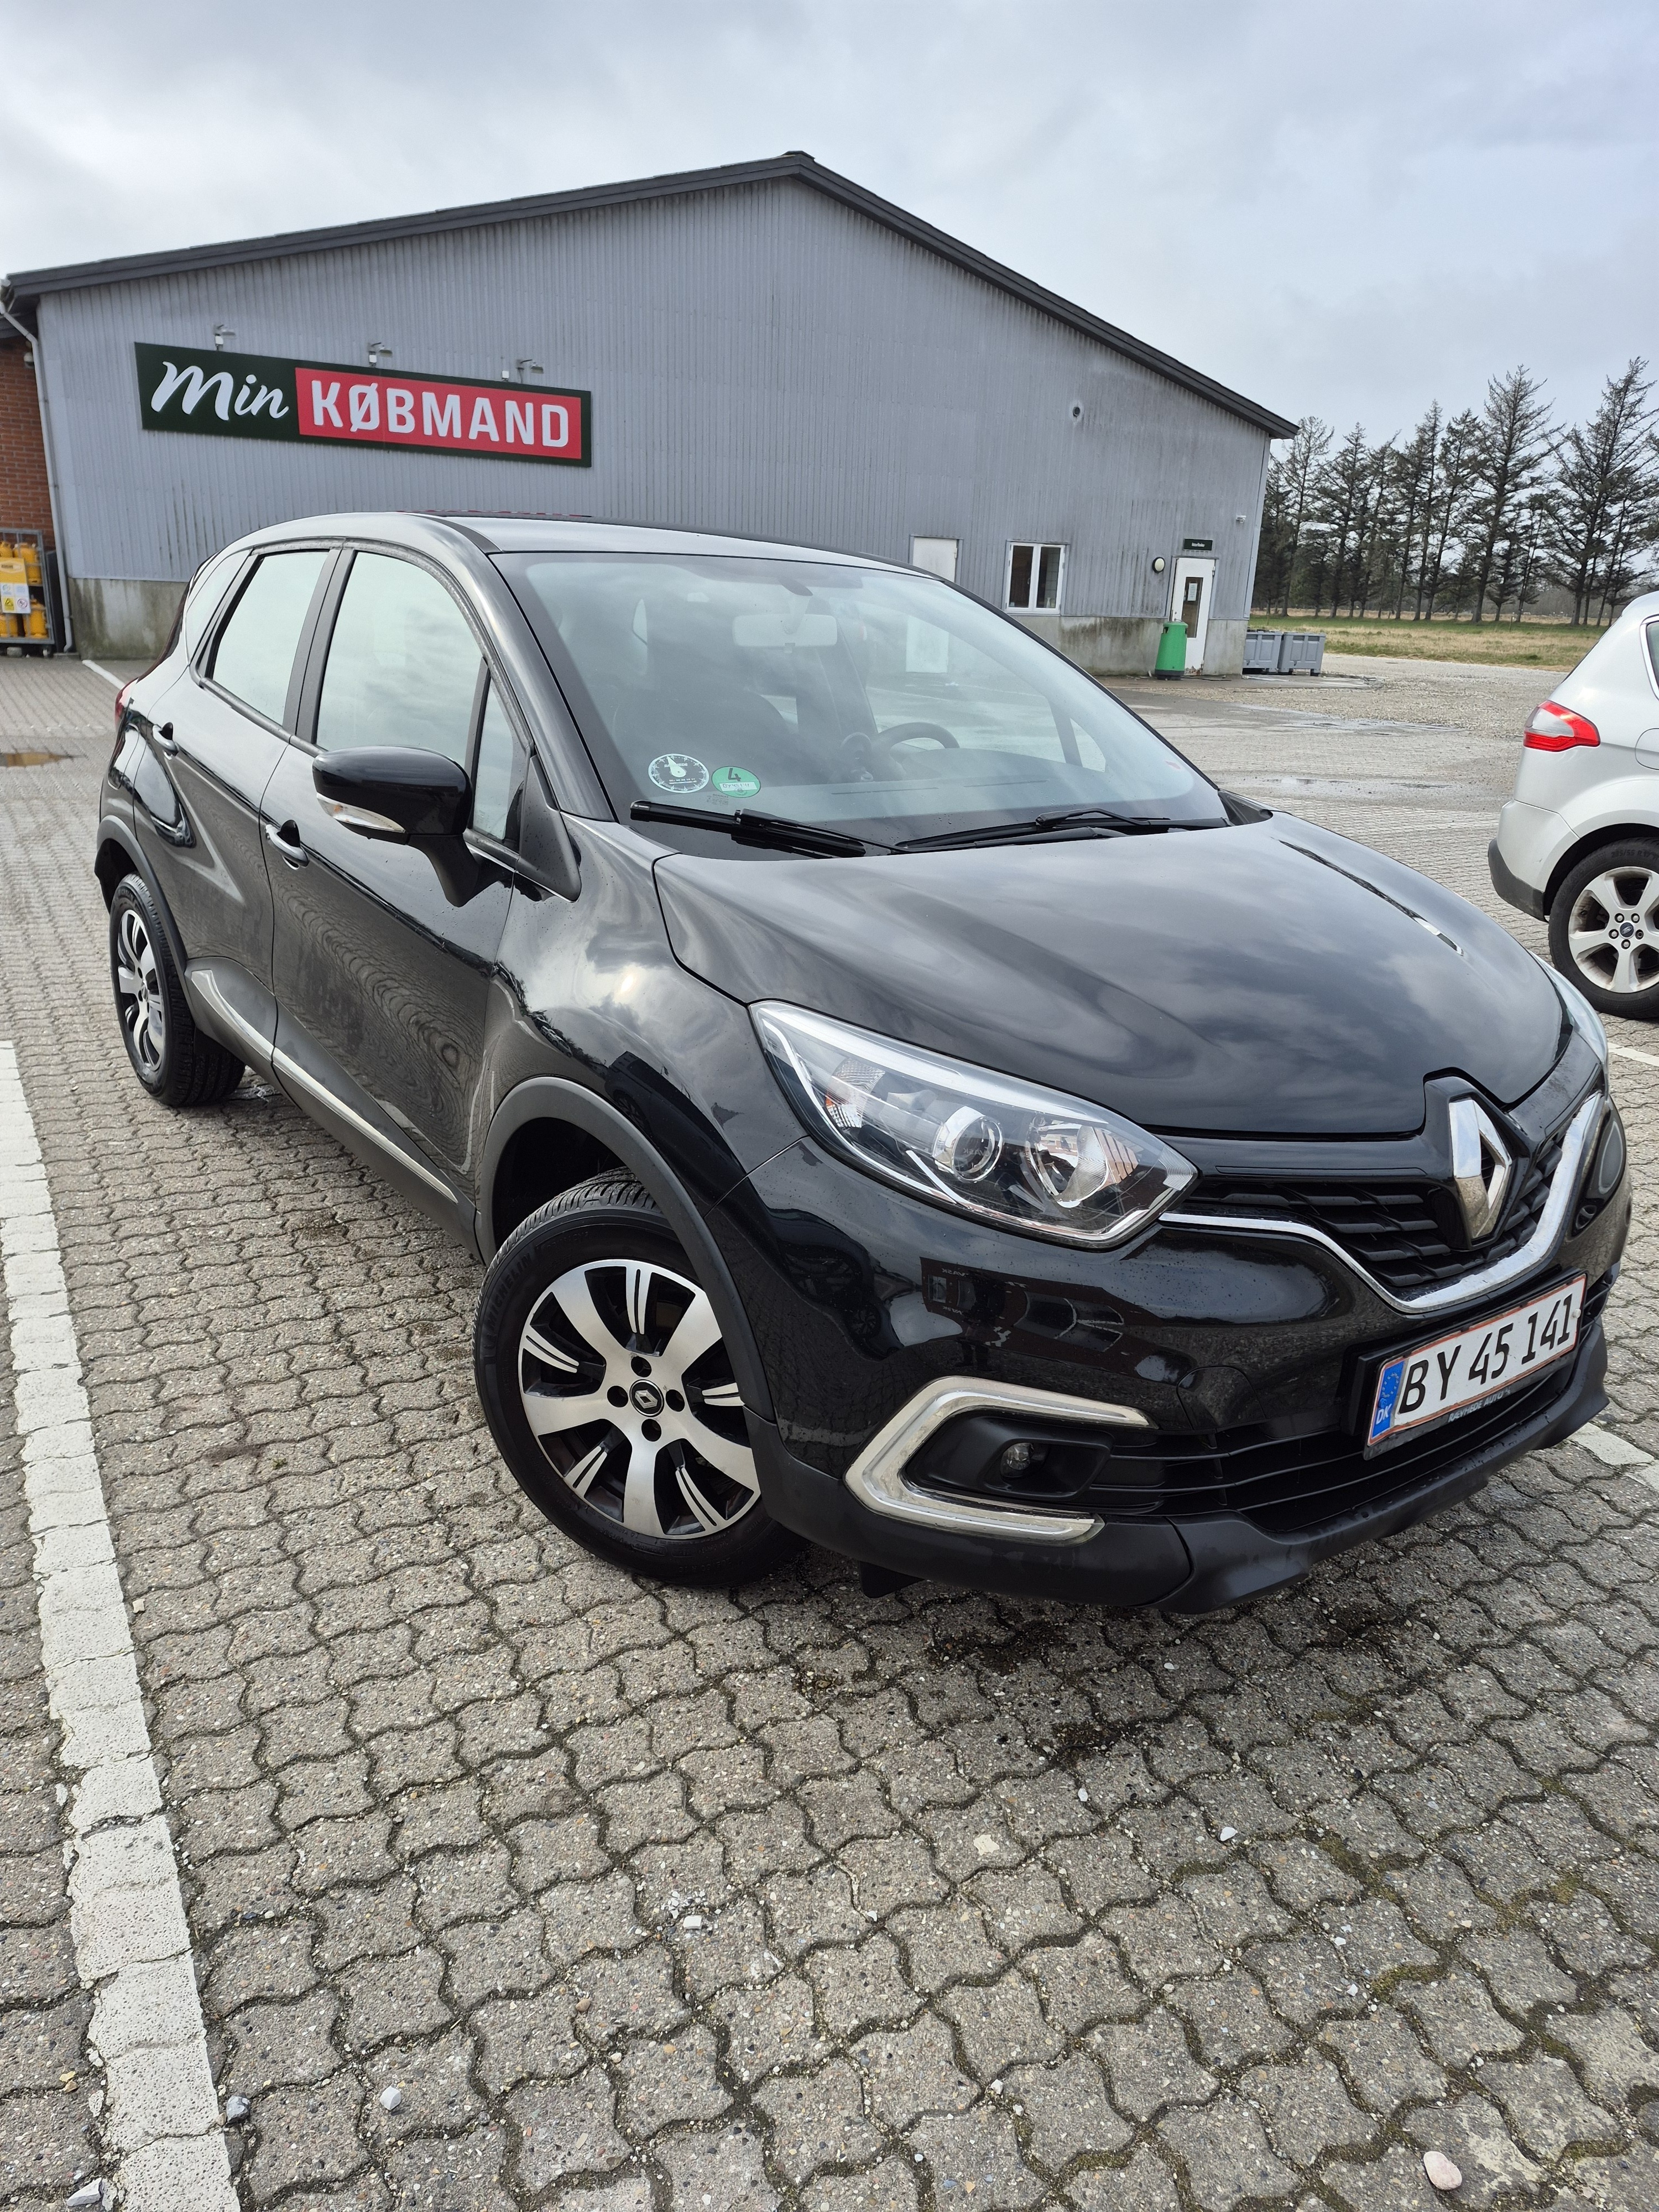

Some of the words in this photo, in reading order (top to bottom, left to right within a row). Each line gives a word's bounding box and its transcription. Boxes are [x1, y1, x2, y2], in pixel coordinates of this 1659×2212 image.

[151, 361, 289, 421] Min
[311, 380, 568, 448] KØBMAND
[728, 768, 741, 781] 4
[1397, 1344, 1462, 1415] BY
[1468, 1322, 1514, 1385] 45
[1521, 1293, 1573, 1365] 141
[1483, 1390, 1504, 1407] AUTO
[1376, 1404, 1392, 1425] DK
